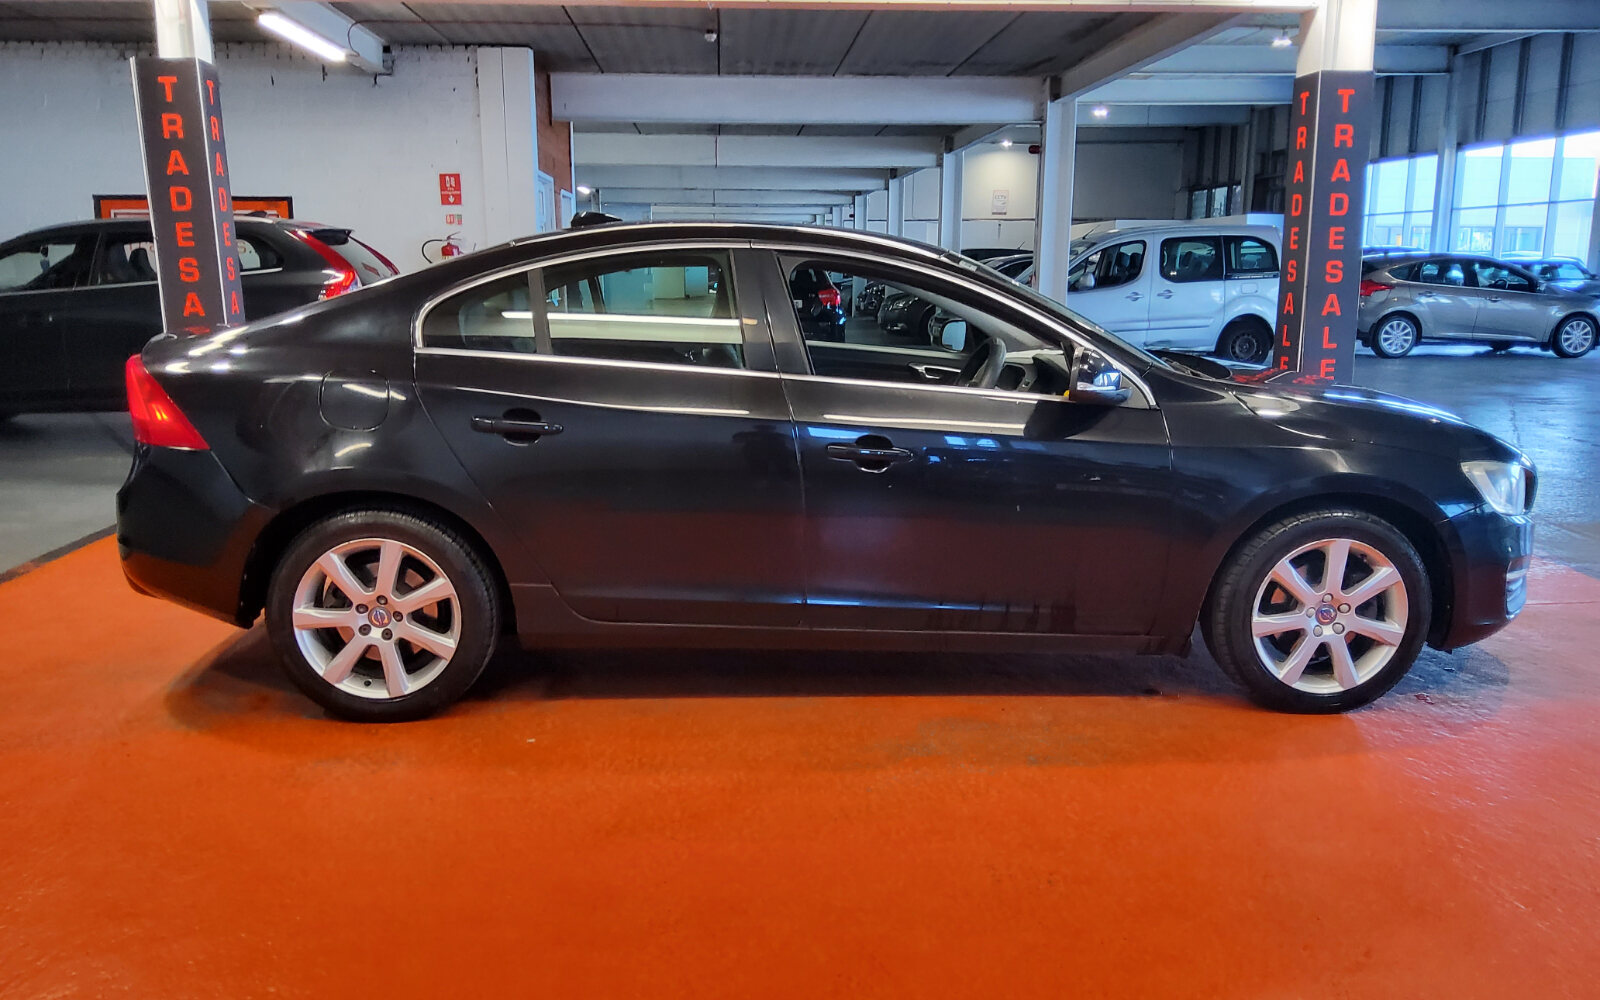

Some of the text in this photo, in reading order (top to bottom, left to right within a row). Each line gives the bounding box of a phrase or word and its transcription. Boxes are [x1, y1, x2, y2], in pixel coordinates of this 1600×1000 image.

[157, 75, 206, 317] TRADESA
[206, 79, 240, 315] TRADESA
[1319, 88, 1356, 380] TRADESALE
